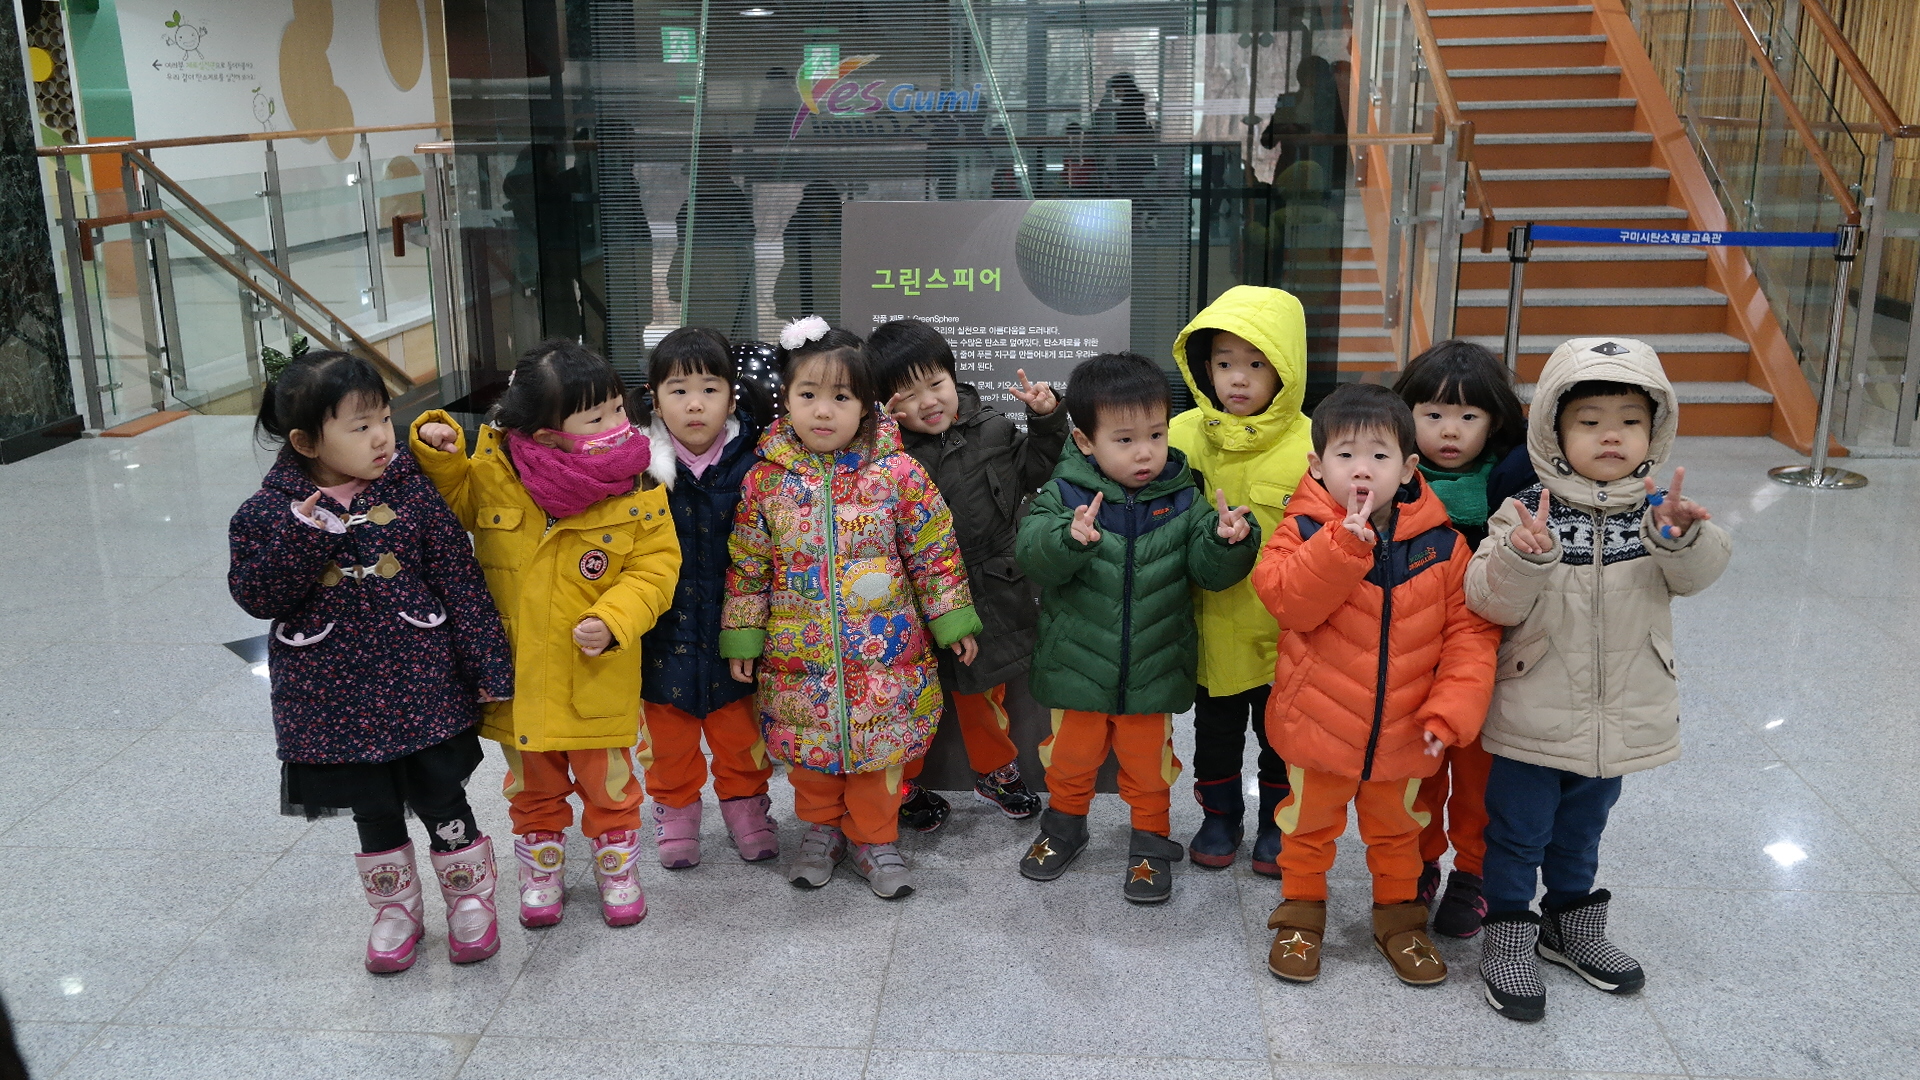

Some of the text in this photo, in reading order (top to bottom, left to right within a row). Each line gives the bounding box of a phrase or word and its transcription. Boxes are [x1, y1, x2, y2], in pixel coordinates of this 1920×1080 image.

[887, 83, 982, 112] Gumi
[1620, 230, 1722, 245] 구미시탄소제로교육관
[871, 267, 1001, 296] 그린스피어
[872, 314, 888, 324] 작품
[957, 325, 987, 335] 실천으로
[988, 325, 1026, 335] 아름다움을
[1027, 325, 1061, 335] 드러내다.
[960, 337, 983, 348] 수많은
[984, 338, 1008, 348] 탄소로
[1009, 338, 1042, 348] 덮여있다.
[1043, 338, 1081, 348] 탄소제로를
[1083, 338, 1099, 347] 위한
[959, 350, 975, 360] 줄여
[976, 350, 993, 360] 푸른
[994, 350, 1017, 360] 지구를
[1018, 350, 1056, 360] 만들어내게
[1057, 350, 1074, 359] 되고
[959, 362, 975, 372] 보게
[976, 362, 995, 372] 된다.
[977, 381, 995, 390] 문제,
